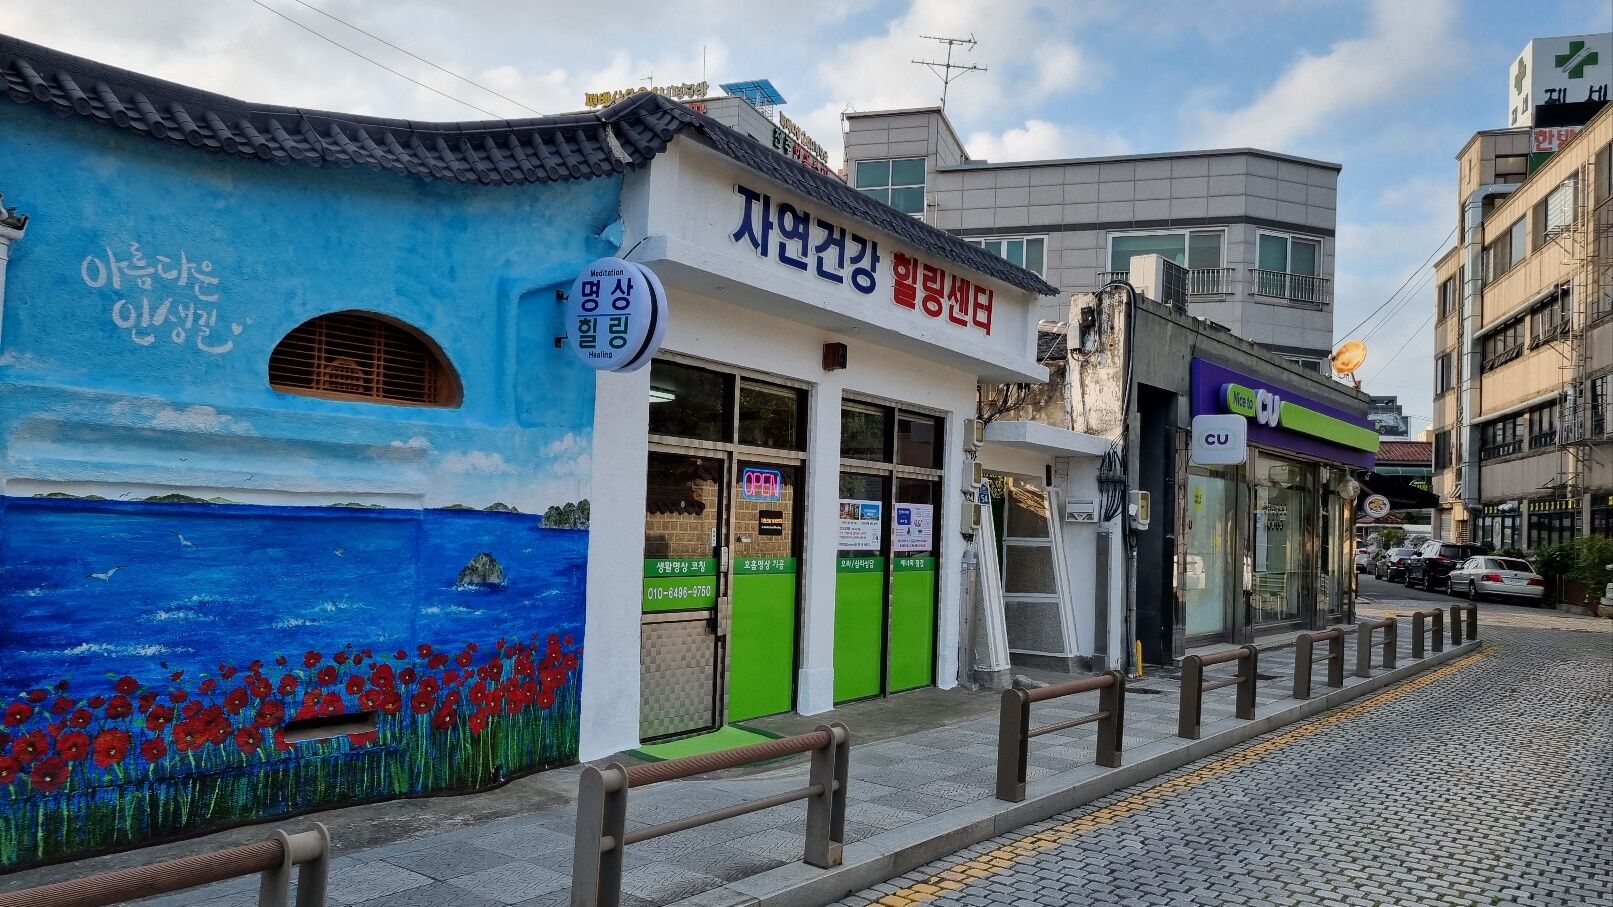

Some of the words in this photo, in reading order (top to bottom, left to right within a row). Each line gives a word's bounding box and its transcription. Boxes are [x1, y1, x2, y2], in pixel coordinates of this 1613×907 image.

[81, 241, 219, 301] 아름다운
[591, 269, 624, 278] Meditation
[728, 184, 880, 294] 자연건강
[891, 251, 994, 336] 힐링센터
[581, 277, 634, 312] 명상
[112, 297, 234, 354] 인생길
[578, 316, 629, 349] 힐링
[588, 350, 613, 359] Healing
[1232, 390, 1246, 408] Nice
[1256, 388, 1280, 427] CU
[1204, 433, 1229, 446] CU
[744, 471, 779, 497] OPEN
[656, 561, 689, 573] 생활명상
[690, 560, 706, 573] 코칭
[647, 585, 711, 600] 010-6496-9750
